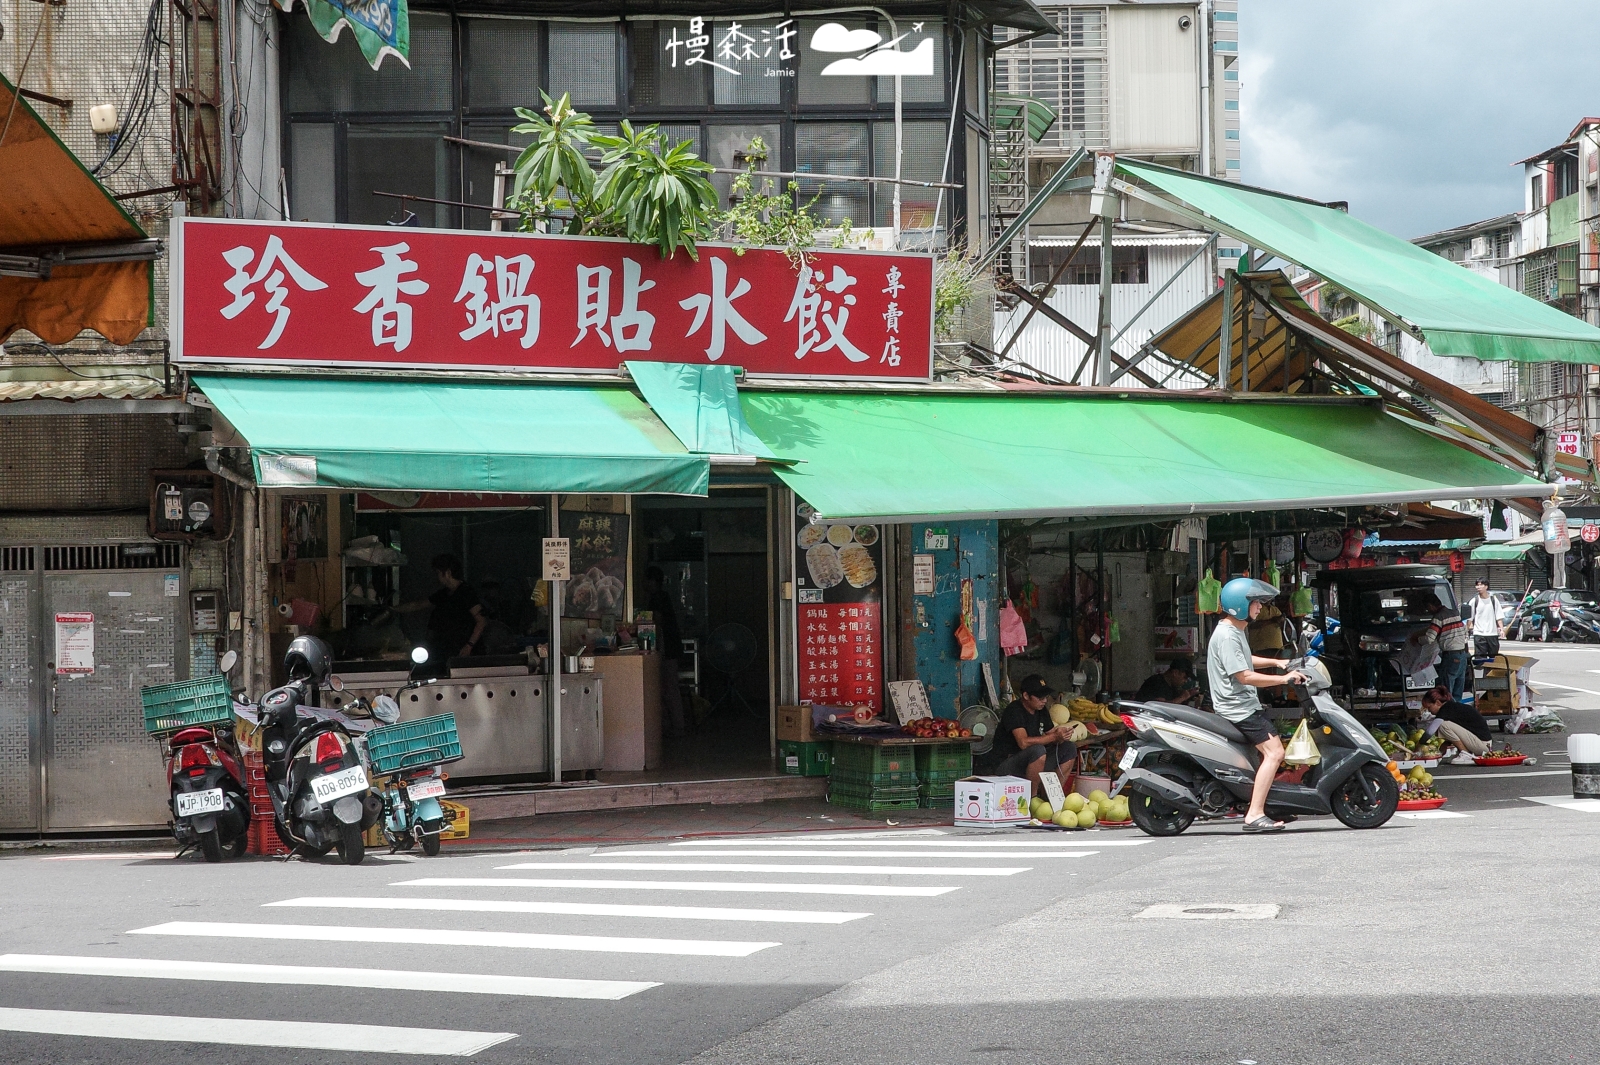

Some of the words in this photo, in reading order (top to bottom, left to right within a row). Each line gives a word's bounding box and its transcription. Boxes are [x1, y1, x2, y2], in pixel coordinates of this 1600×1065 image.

[220, 234, 870, 363] 珍香鍋貼水餃
[880, 265, 905, 367] 專賣店
[577, 515, 612, 532] 麻辣
[1584, 532, 1597, 540] 食堂
[575, 534, 612, 553] 水餃
[935, 539, 944, 548] 29
[807, 609, 828, 618] 鍋貼
[807, 623, 828, 632] 水餃
[806, 634, 848, 644] 大腸麵線
[807, 646, 838, 656] 酸辣湯
[809, 660, 838, 670] 玉米湯
[808, 674, 838, 684] 魚丸湯
[808, 687, 838, 697] 冰豆漿
[817, 752, 829, 762] 100
[179, 794, 222, 812] MJP-1908
